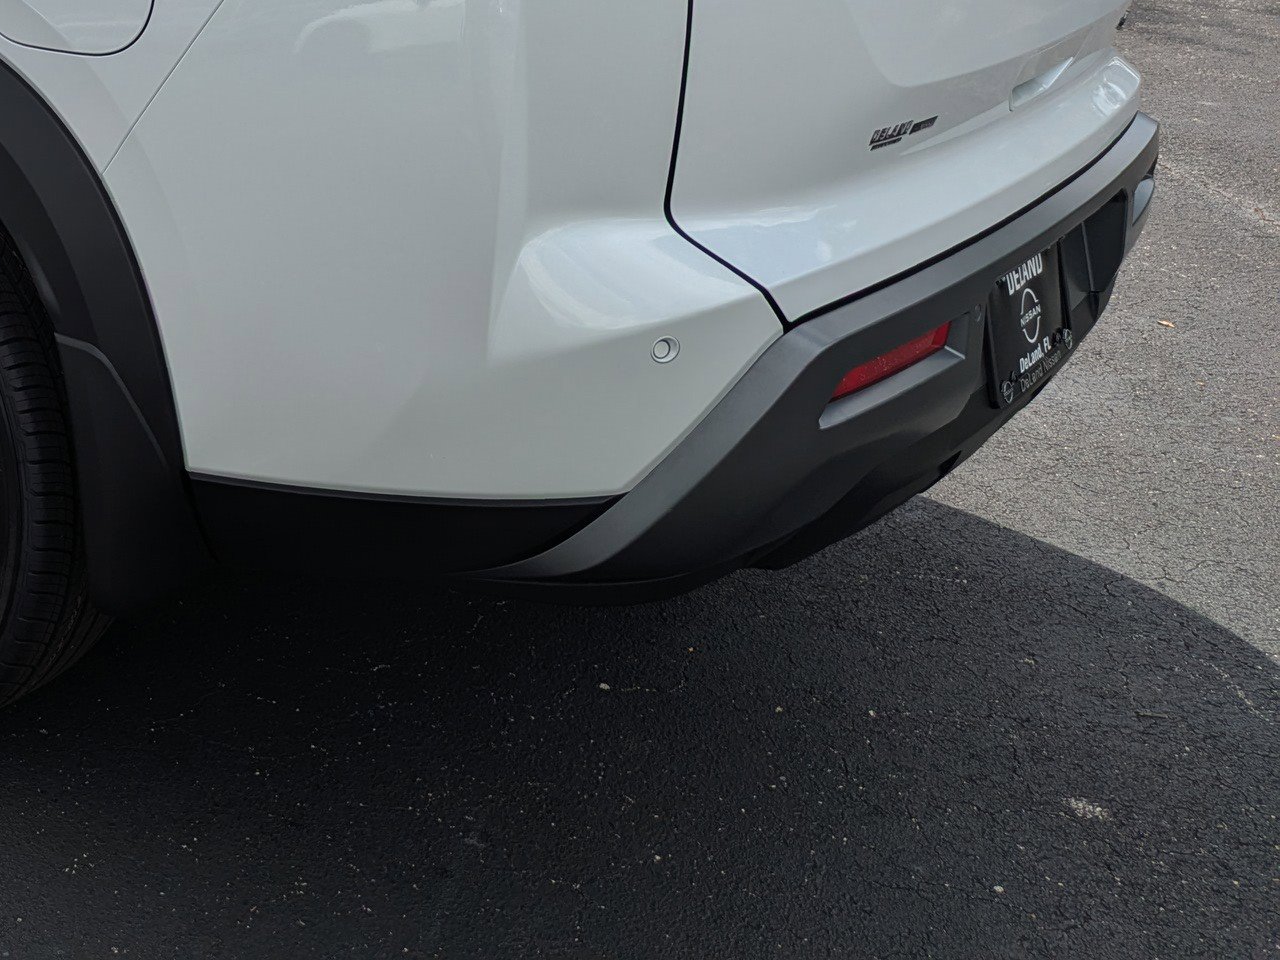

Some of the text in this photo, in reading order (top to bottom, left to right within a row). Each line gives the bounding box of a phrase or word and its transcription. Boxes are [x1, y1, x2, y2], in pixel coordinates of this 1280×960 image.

[1006, 252, 1044, 296] DELAND
[1020, 304, 1042, 328] NISSAN
[1043, 335, 1052, 354] FL
